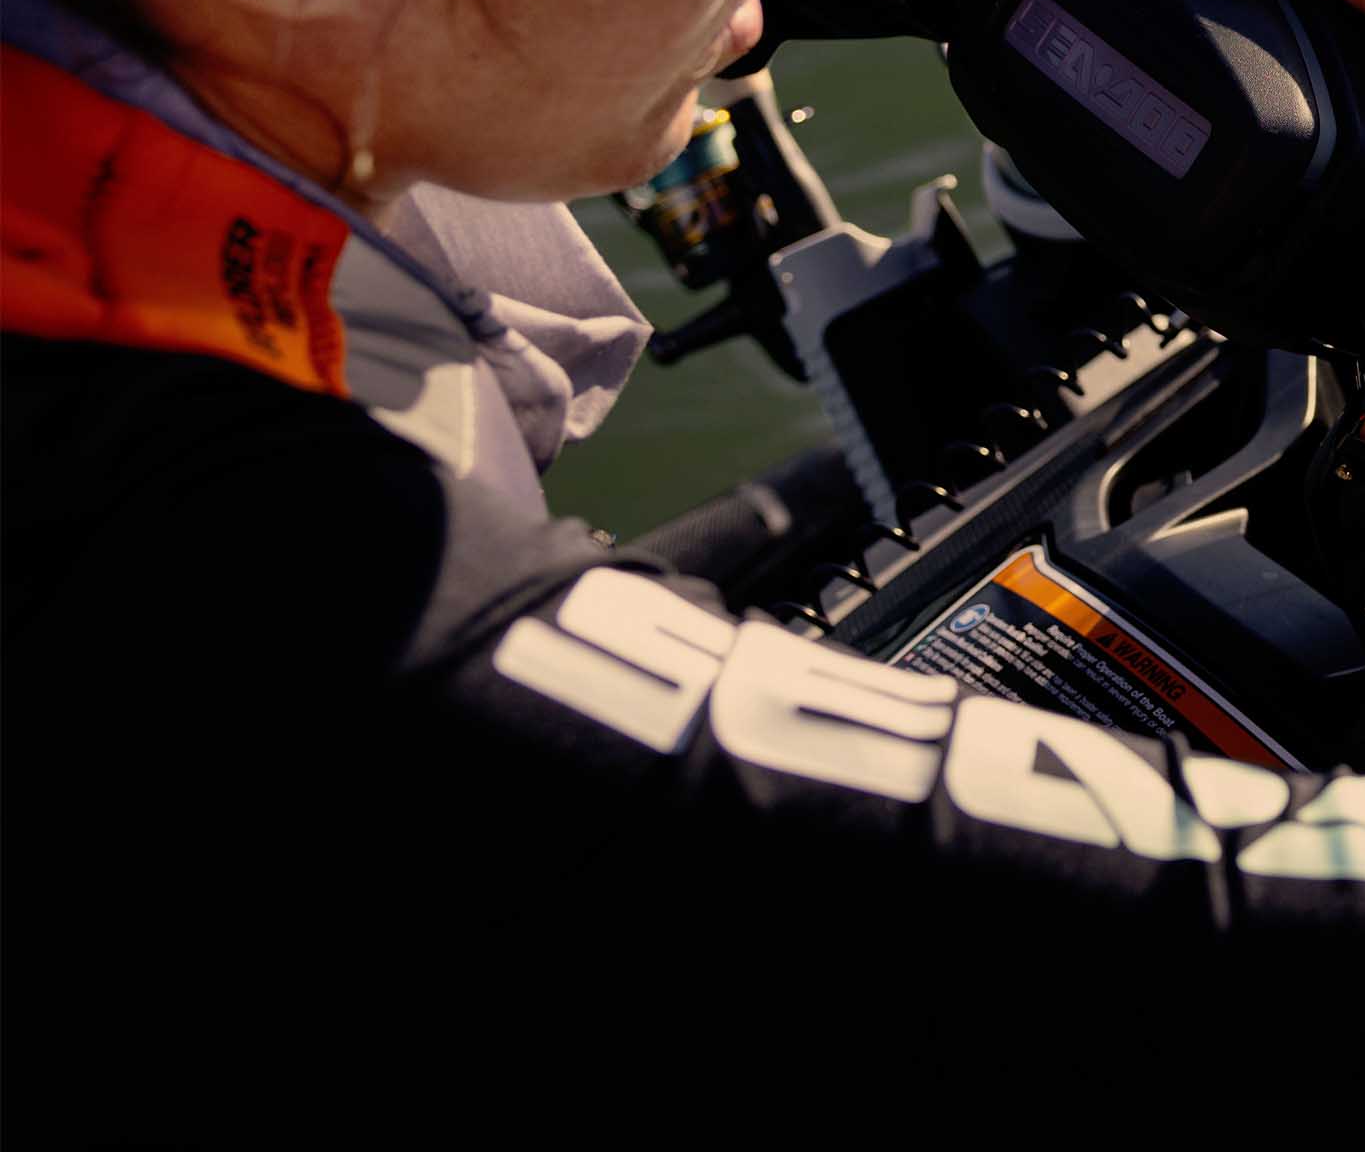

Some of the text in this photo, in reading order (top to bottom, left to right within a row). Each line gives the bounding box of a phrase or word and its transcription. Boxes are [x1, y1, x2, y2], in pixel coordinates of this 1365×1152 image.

[1073, 643, 1098, 664] Proper
[1095, 660, 1133, 693] Operation
[1130, 689, 1145, 701] of
[1139, 695, 1154, 711] the
[1153, 706, 1176, 728] Boat
[1113, 642, 1187, 700] WARNING
[1108, 686, 1132, 706] severe
[1129, 704, 1149, 723] injury
